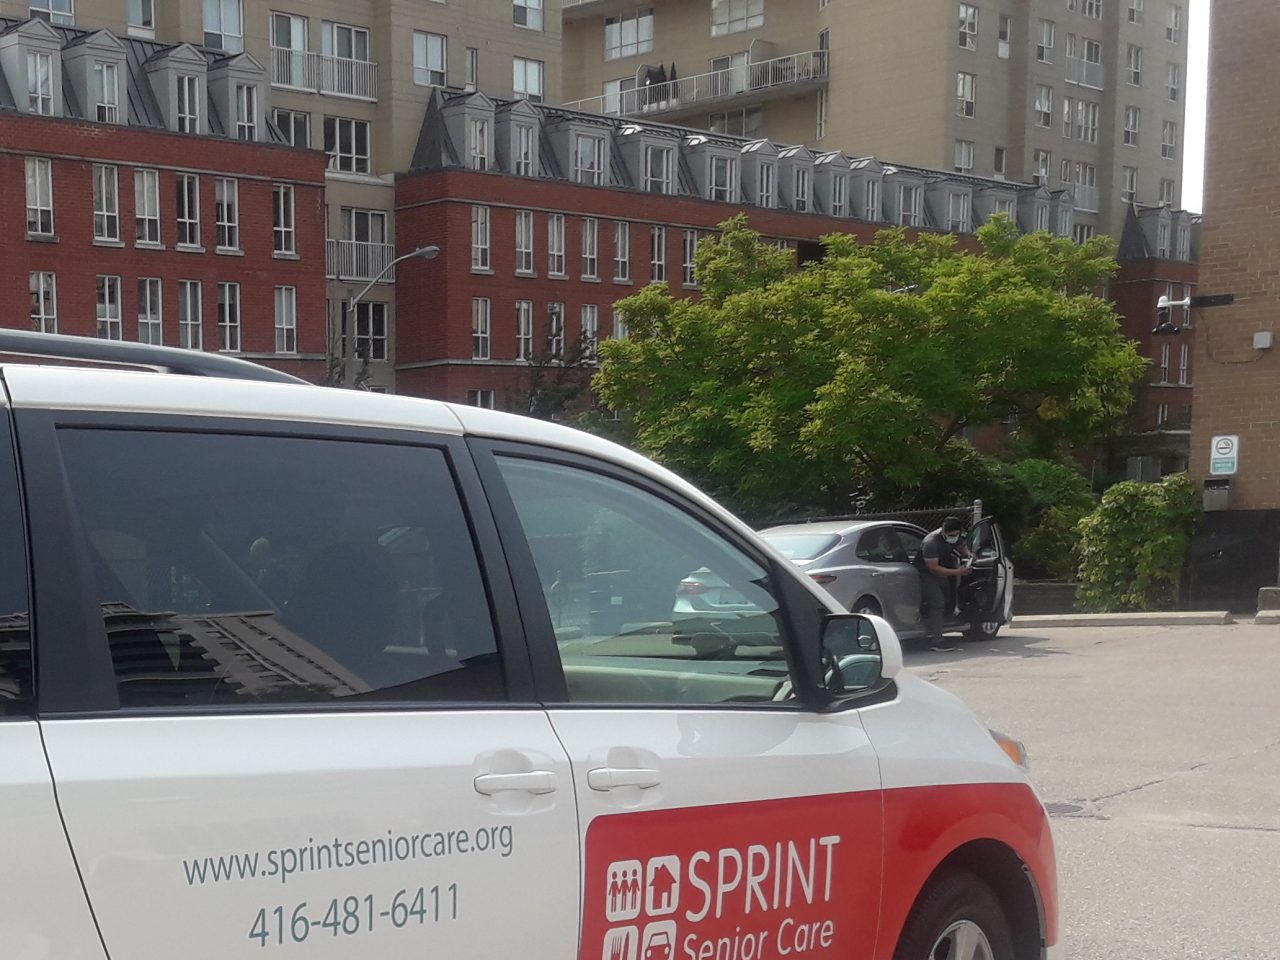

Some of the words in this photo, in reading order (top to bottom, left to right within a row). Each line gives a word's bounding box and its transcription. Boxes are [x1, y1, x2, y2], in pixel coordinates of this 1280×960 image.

[183, 824, 513, 885] www.sprintseniorcare.org
[685, 835, 840, 923] SPRINT
[248, 882, 459, 947] 416-481-6411
[776, 918, 834, 956] Care
